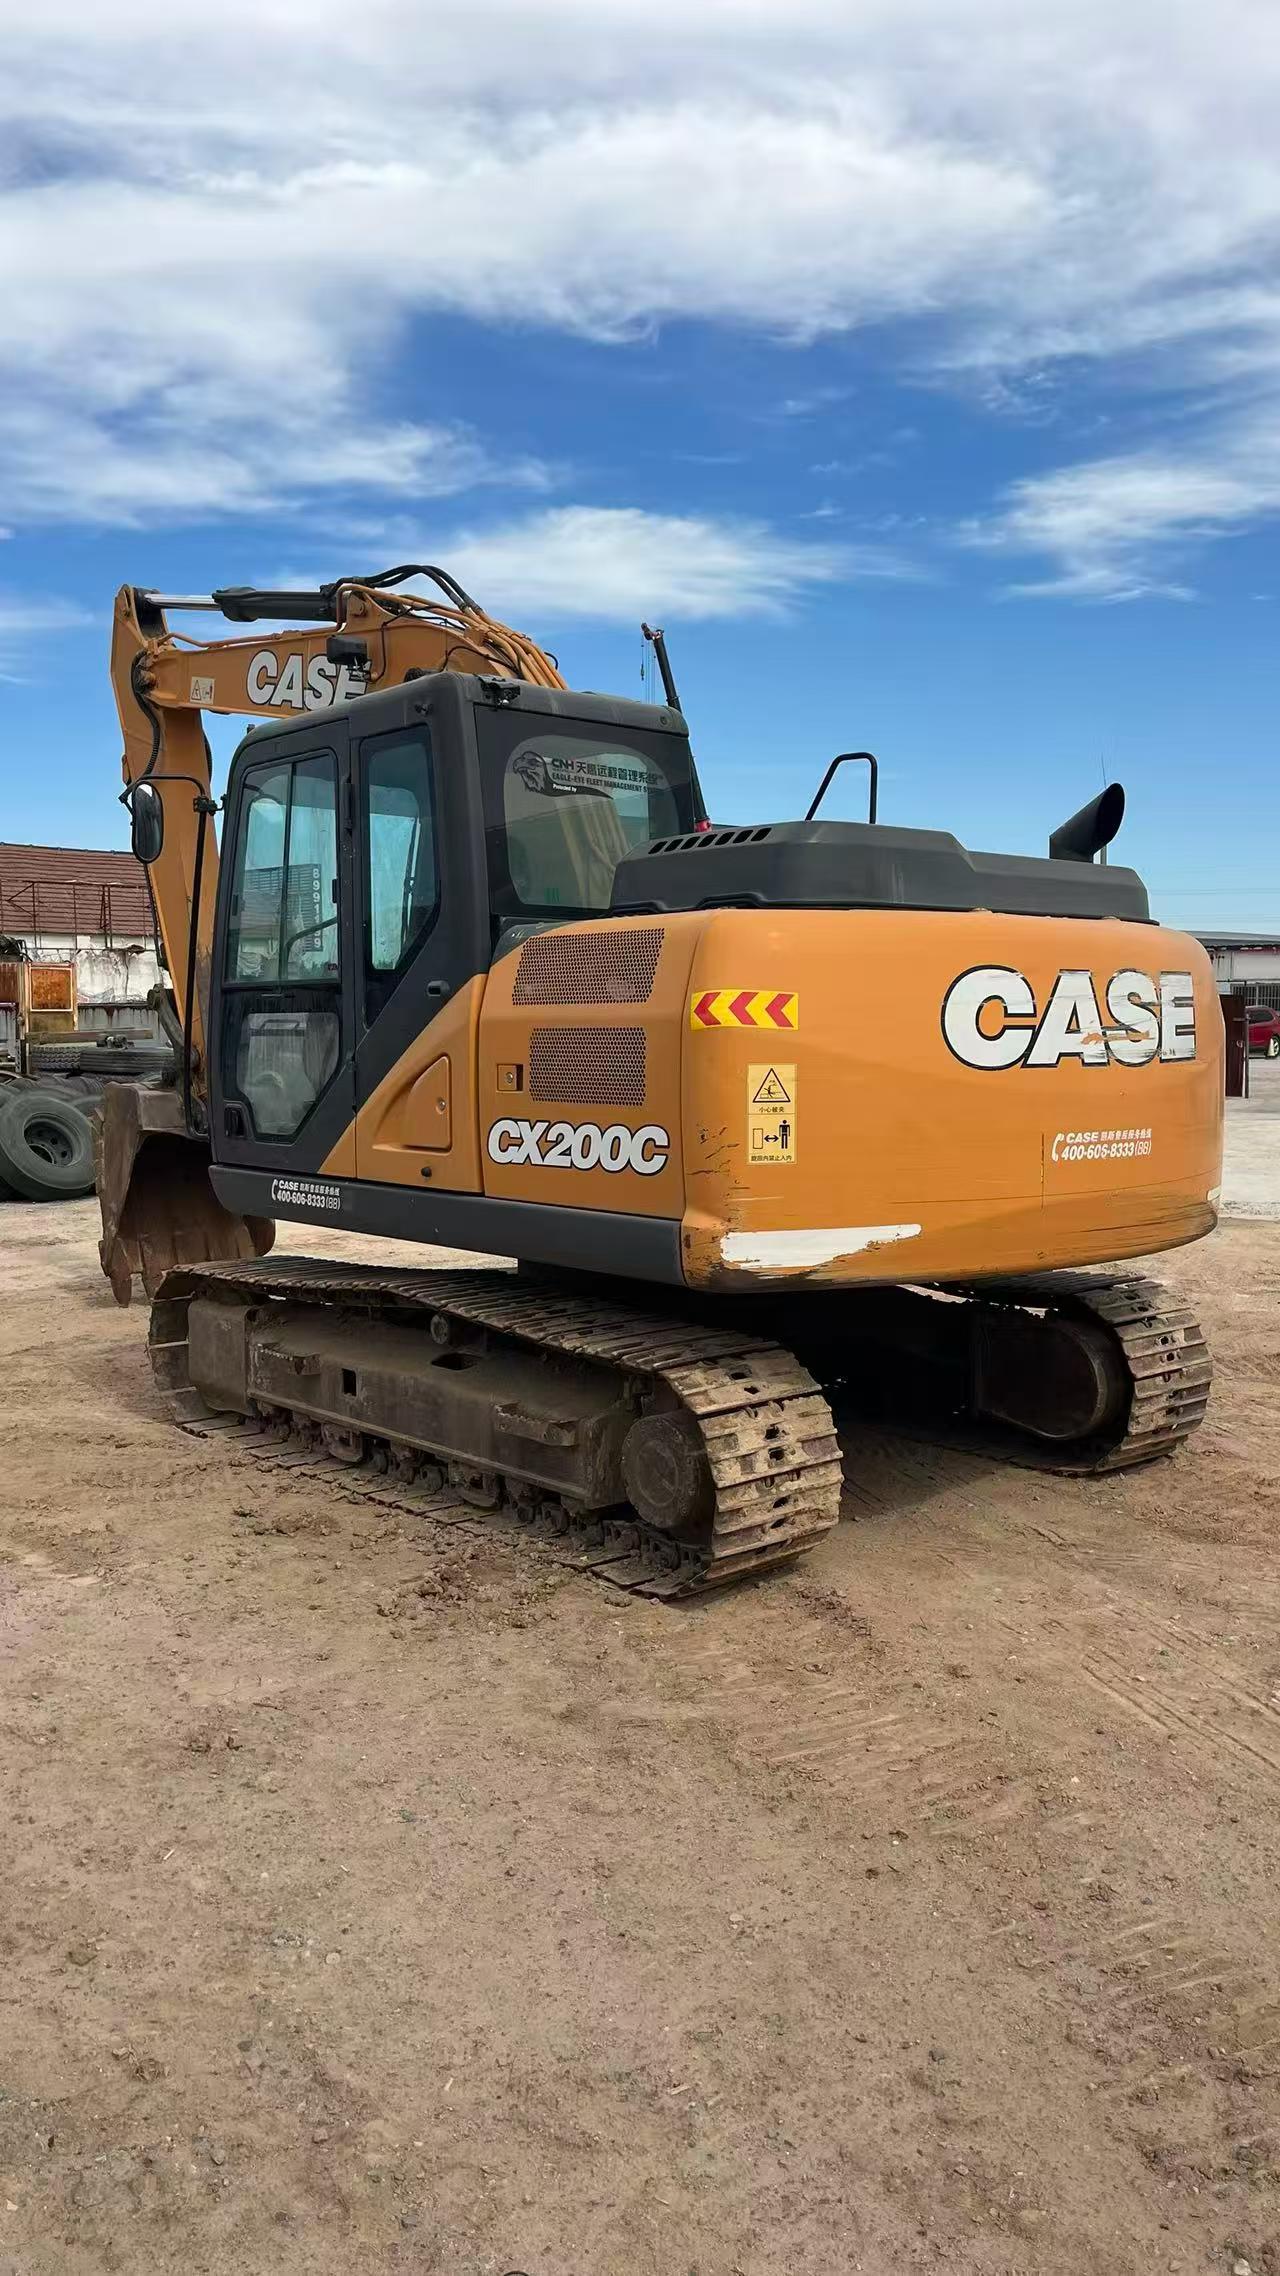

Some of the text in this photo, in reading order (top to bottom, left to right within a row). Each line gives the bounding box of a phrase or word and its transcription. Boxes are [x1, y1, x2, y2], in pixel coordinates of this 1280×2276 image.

[247, 649, 371, 711] CASE
[552, 758, 575, 770] CNH
[586, 777, 604, 787] FLEET
[604, 779, 642, 792] MANAGEMENT
[941, 964, 1197, 1071] CASE
[1066, 1131, 1099, 1144] CASE
[487, 1117, 670, 1176] CX200C
[278, 1180, 299, 1190] CASE
